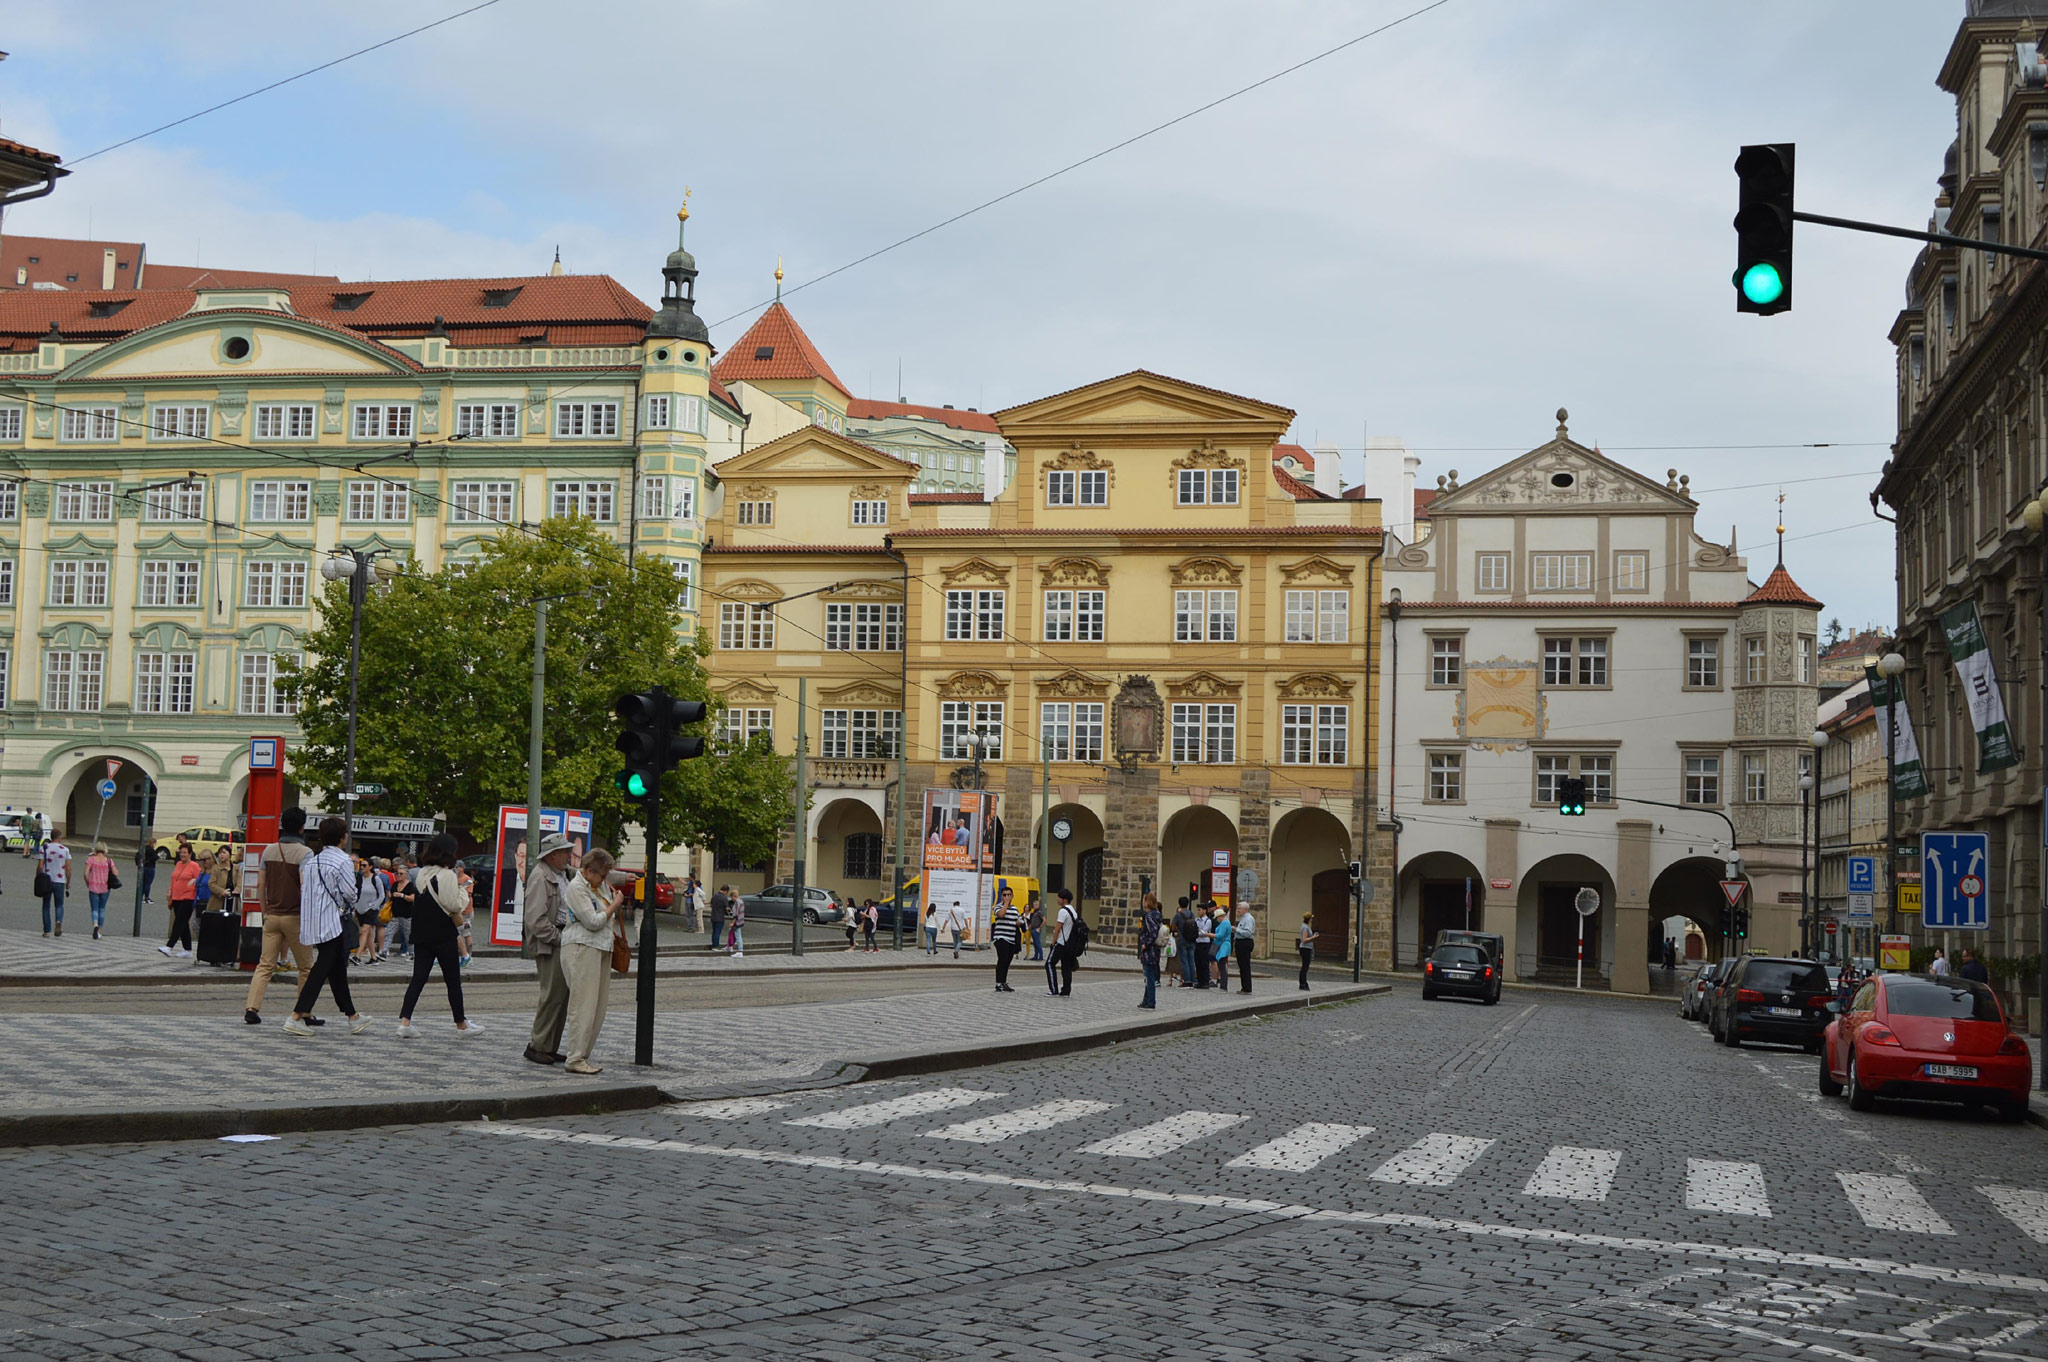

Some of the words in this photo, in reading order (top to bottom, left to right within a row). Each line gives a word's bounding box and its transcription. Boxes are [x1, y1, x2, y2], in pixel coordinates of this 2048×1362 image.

[364, 785, 374, 793] WC
[373, 819, 430, 833] Trdelník
[927, 846, 944, 854] VÍCE
[1854, 861, 1868, 881] P
[1931, 1065, 1947, 1074] 5AB
[1953, 1067, 1974, 1076] 5995
